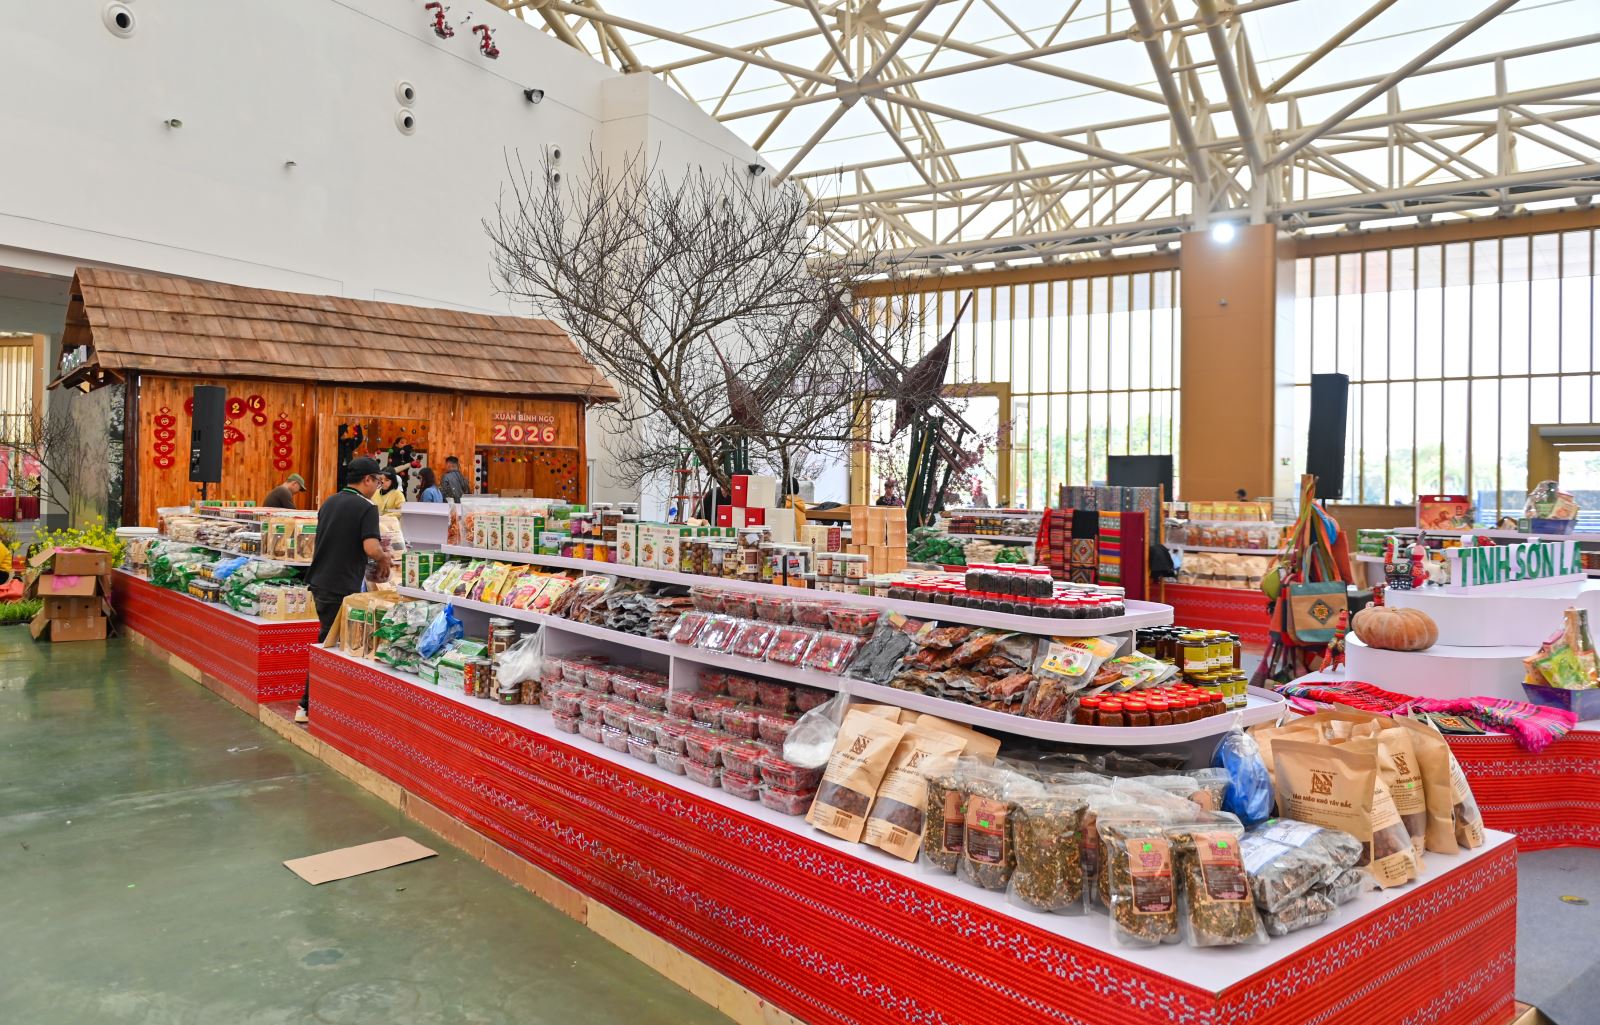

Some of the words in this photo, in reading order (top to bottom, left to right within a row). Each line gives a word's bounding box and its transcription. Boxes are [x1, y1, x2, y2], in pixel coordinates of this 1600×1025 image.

[495, 411, 516, 421] XUÂN
[518, 410, 537, 422] BÌNH
[538, 415, 555, 424] NGỌ
[494, 423, 555, 443] 2026
[1516, 539, 1555, 581] SƠN
[1560, 541, 1583, 576] LA
